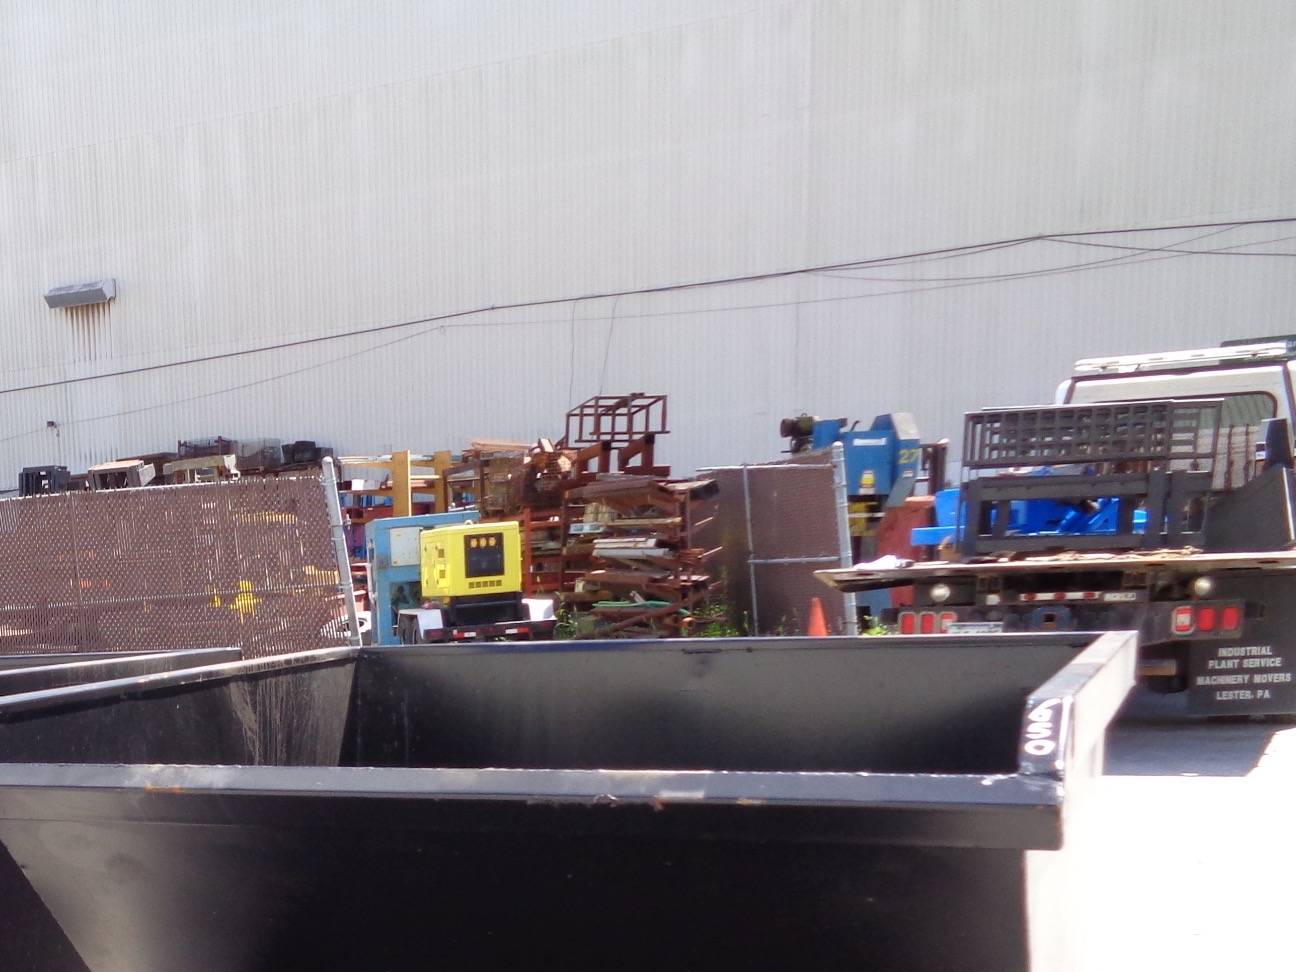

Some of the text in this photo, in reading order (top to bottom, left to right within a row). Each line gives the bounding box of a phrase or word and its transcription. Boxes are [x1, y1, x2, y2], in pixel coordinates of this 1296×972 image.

[899, 448, 920, 464] 27
[1218, 646, 1273, 657] INDUSTRIAL
[1208, 657, 1282, 669] PLANT SERVICE
[1196, 673, 1292, 686] MACHINERY MOVERS
[1257, 689, 1271, 699] PA
[1024, 697, 1062, 756] 650
